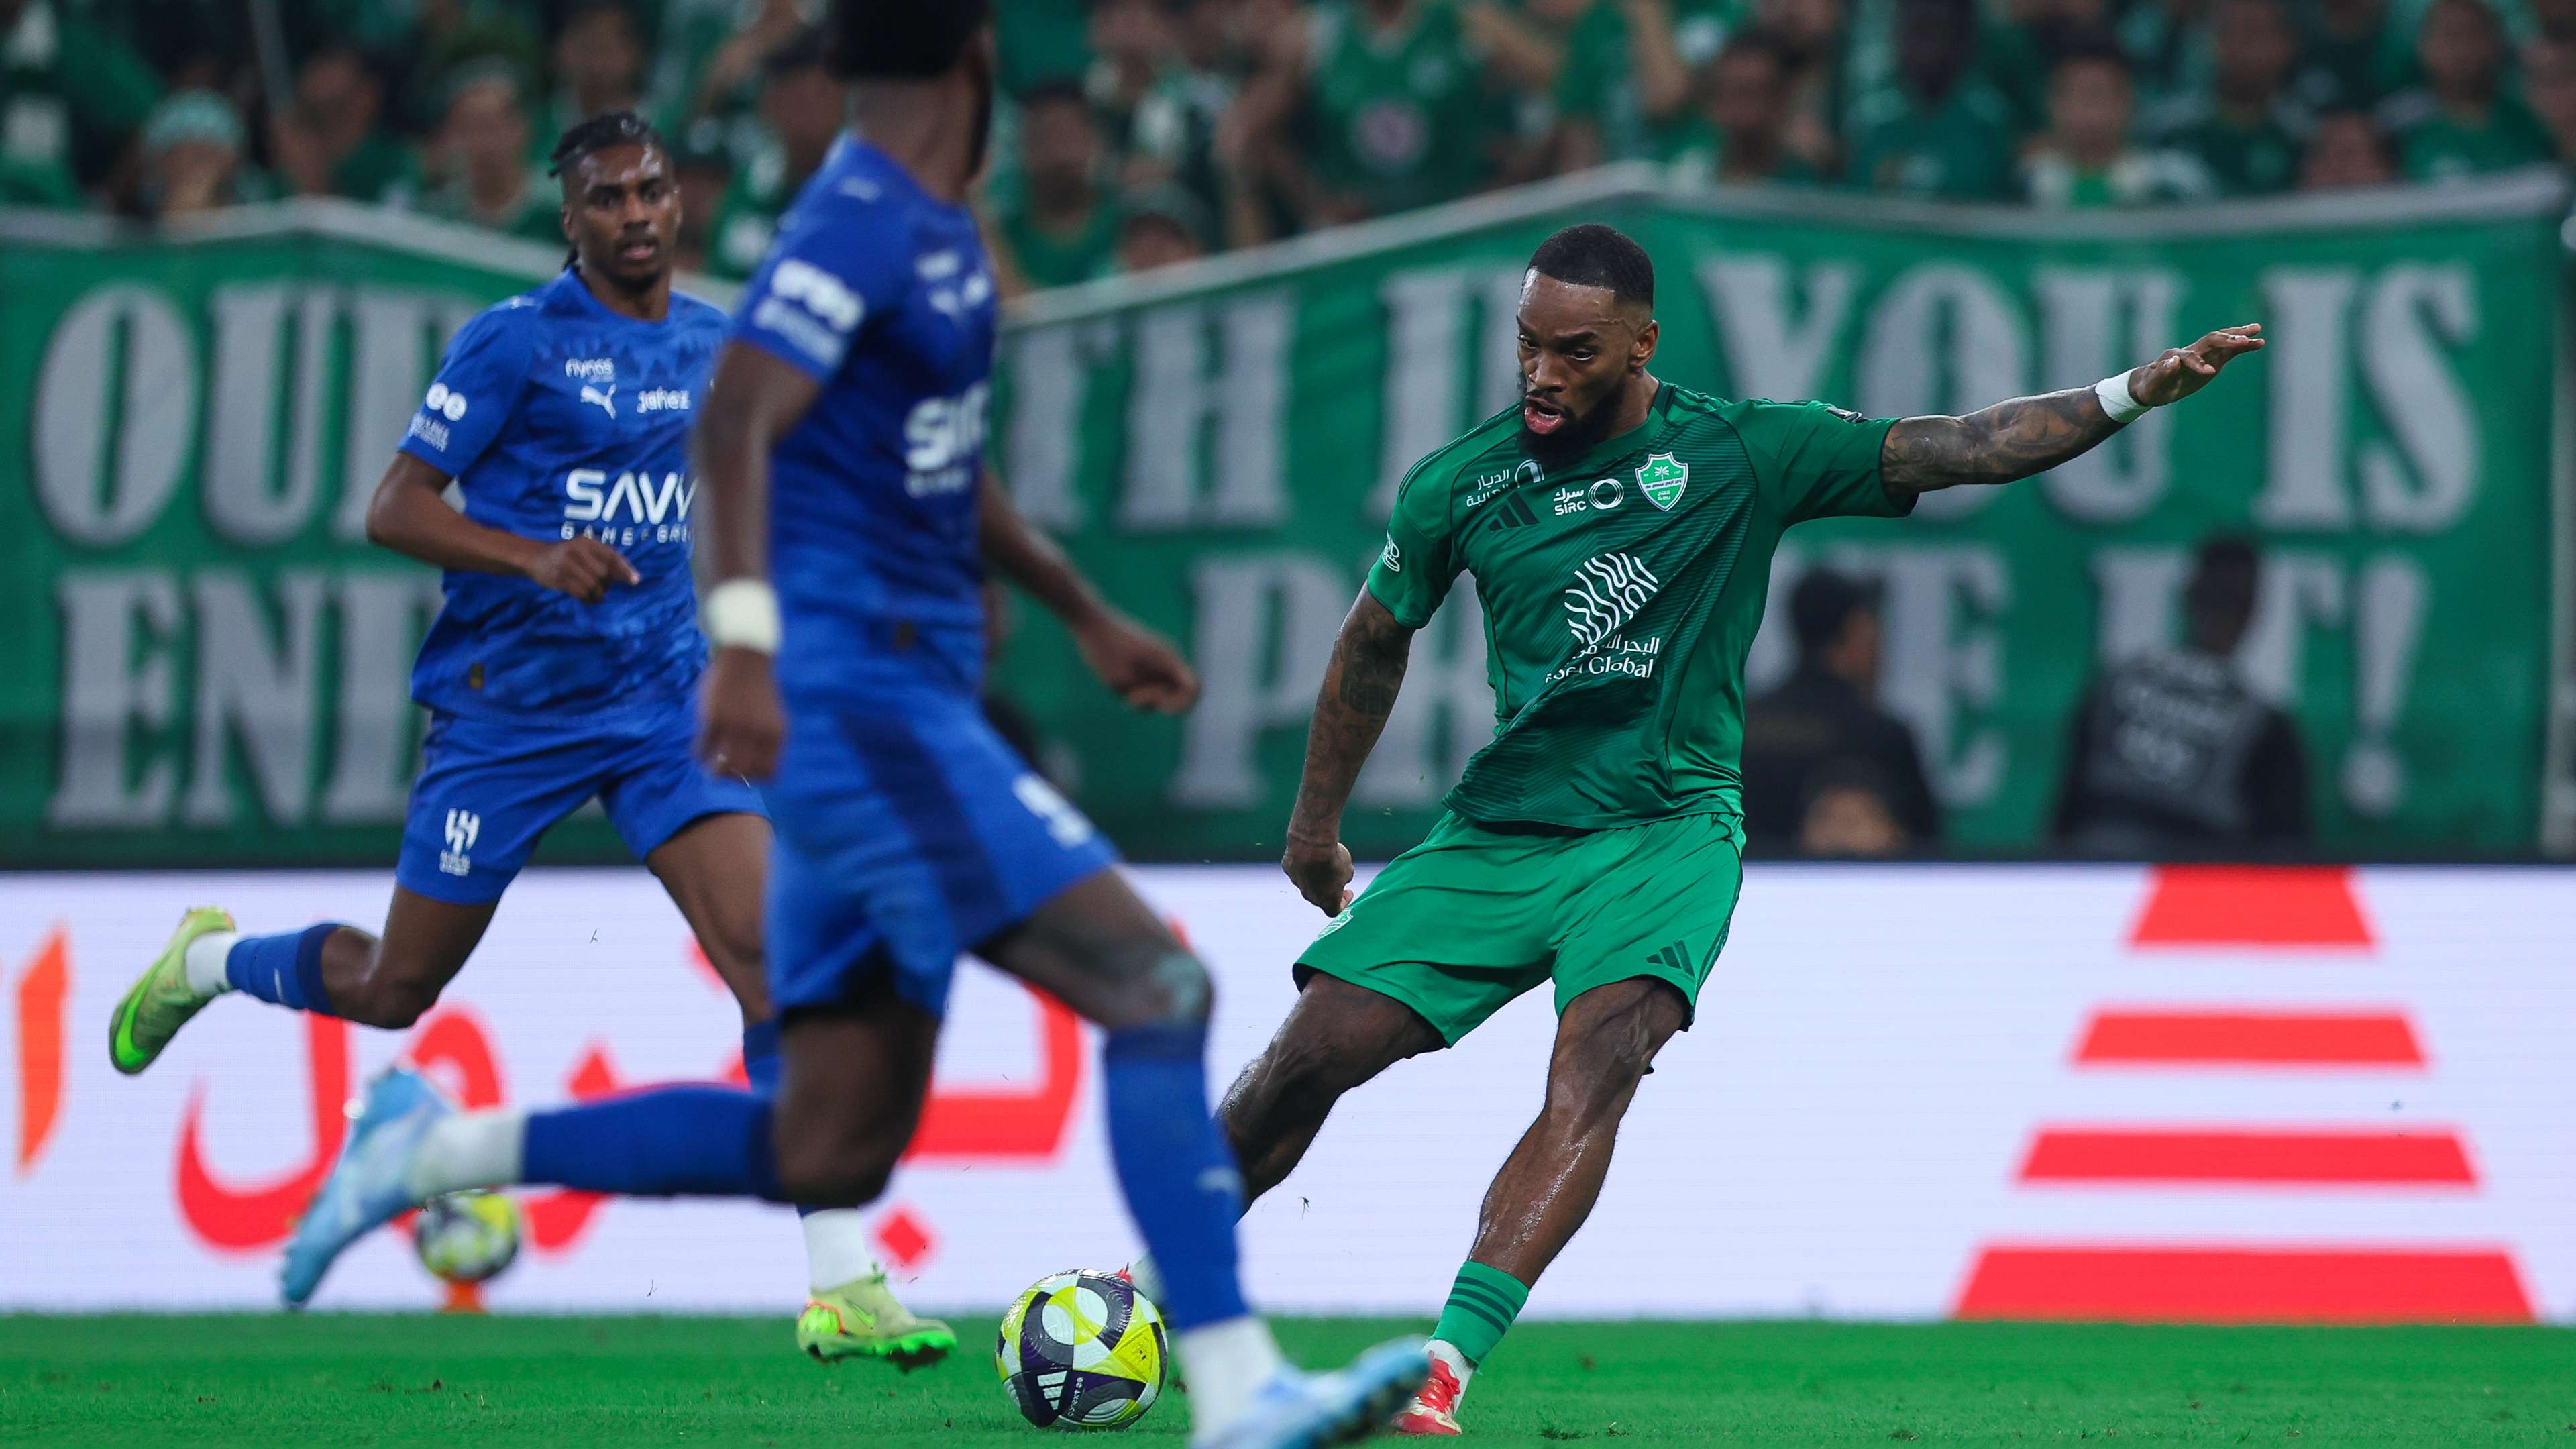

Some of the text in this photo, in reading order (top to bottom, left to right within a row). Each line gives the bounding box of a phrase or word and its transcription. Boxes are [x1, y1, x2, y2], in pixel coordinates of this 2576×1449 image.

[2254, 262, 2479, 533] IS
[1477, 469, 1509, 491] الديار
[1553, 488, 1585, 504] سرك
[1554, 500, 1587, 516] SIRC
[1619, 636, 1660, 655] البحر
[1588, 655, 1654, 679] Global
